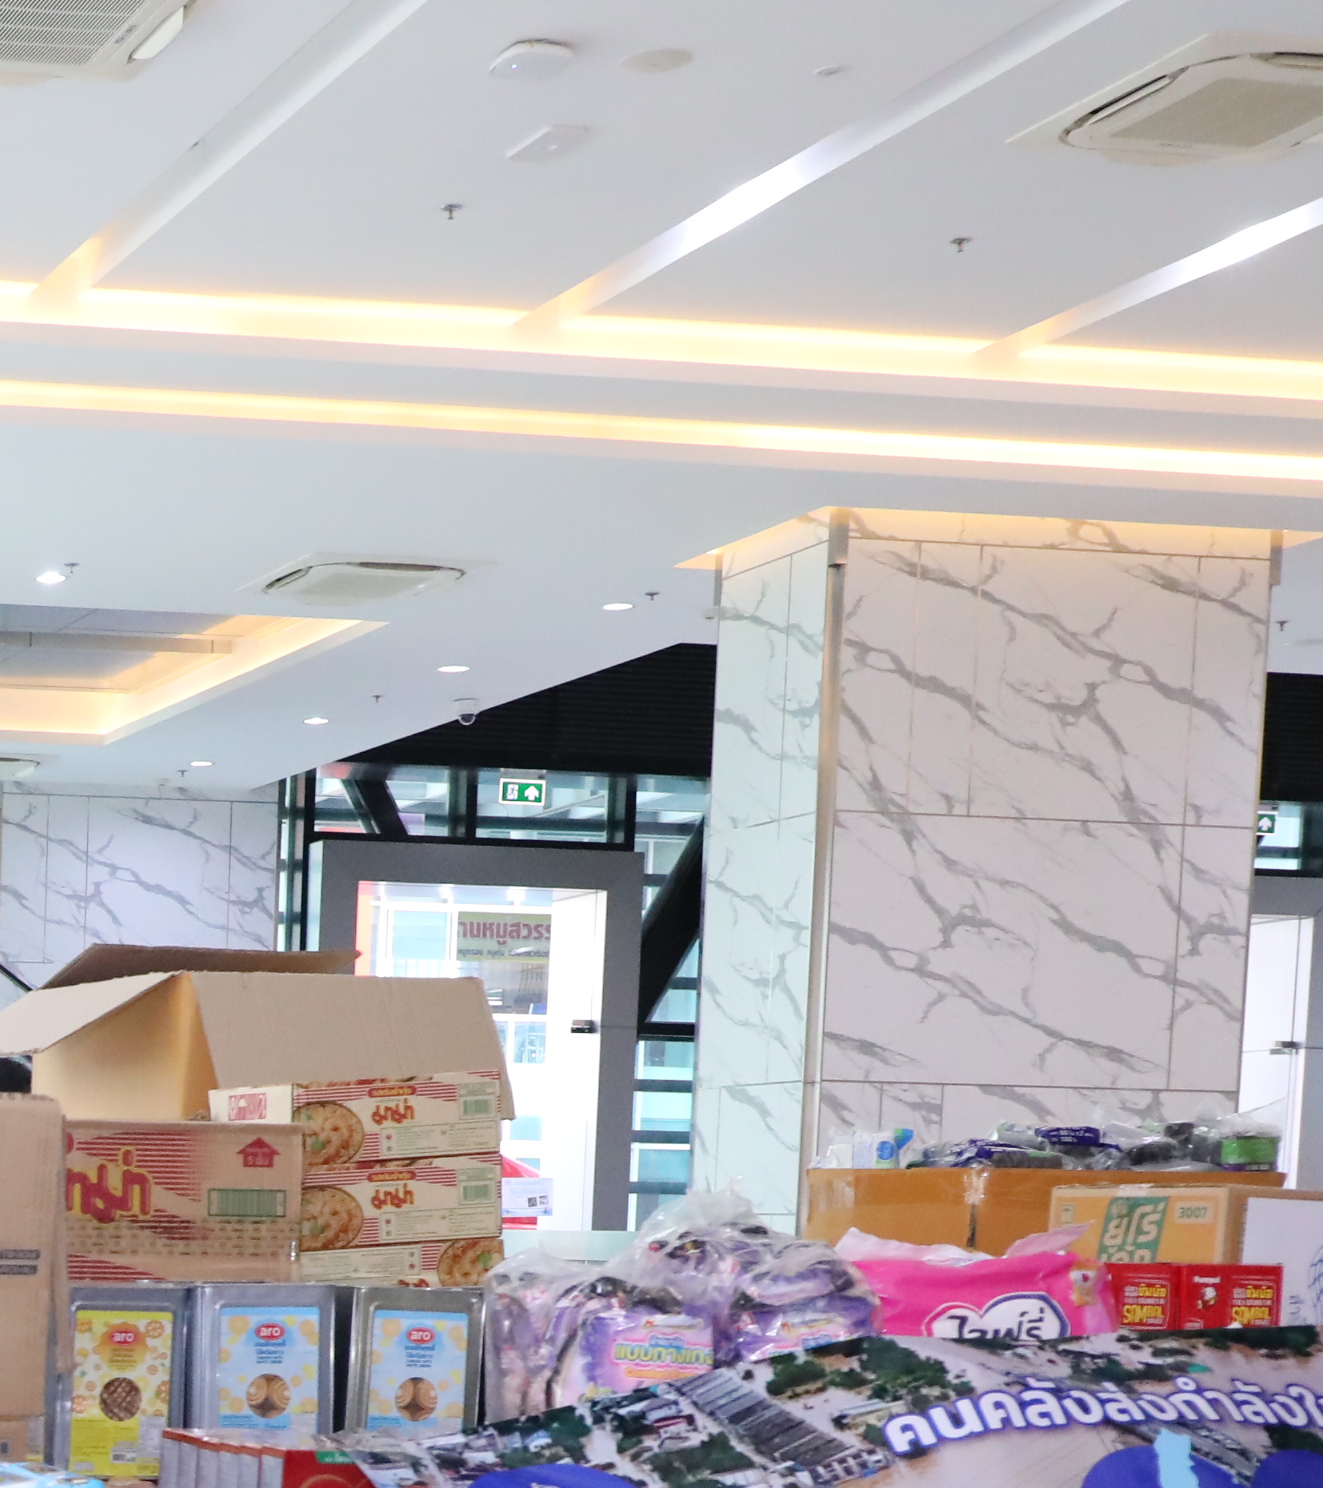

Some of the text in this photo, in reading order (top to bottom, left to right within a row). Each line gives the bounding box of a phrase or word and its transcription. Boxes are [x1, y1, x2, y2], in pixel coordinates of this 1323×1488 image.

[66, 1148, 151, 1224] าม่า
[1178, 1207, 1208, 1219] 3007
[113, 1331, 135, 1342] aro
[259, 1326, 281, 1337] aro
[410, 1329, 432, 1341] aro
[885, 1376, 1323, 1454] คนคลังส่งกำลังใ
